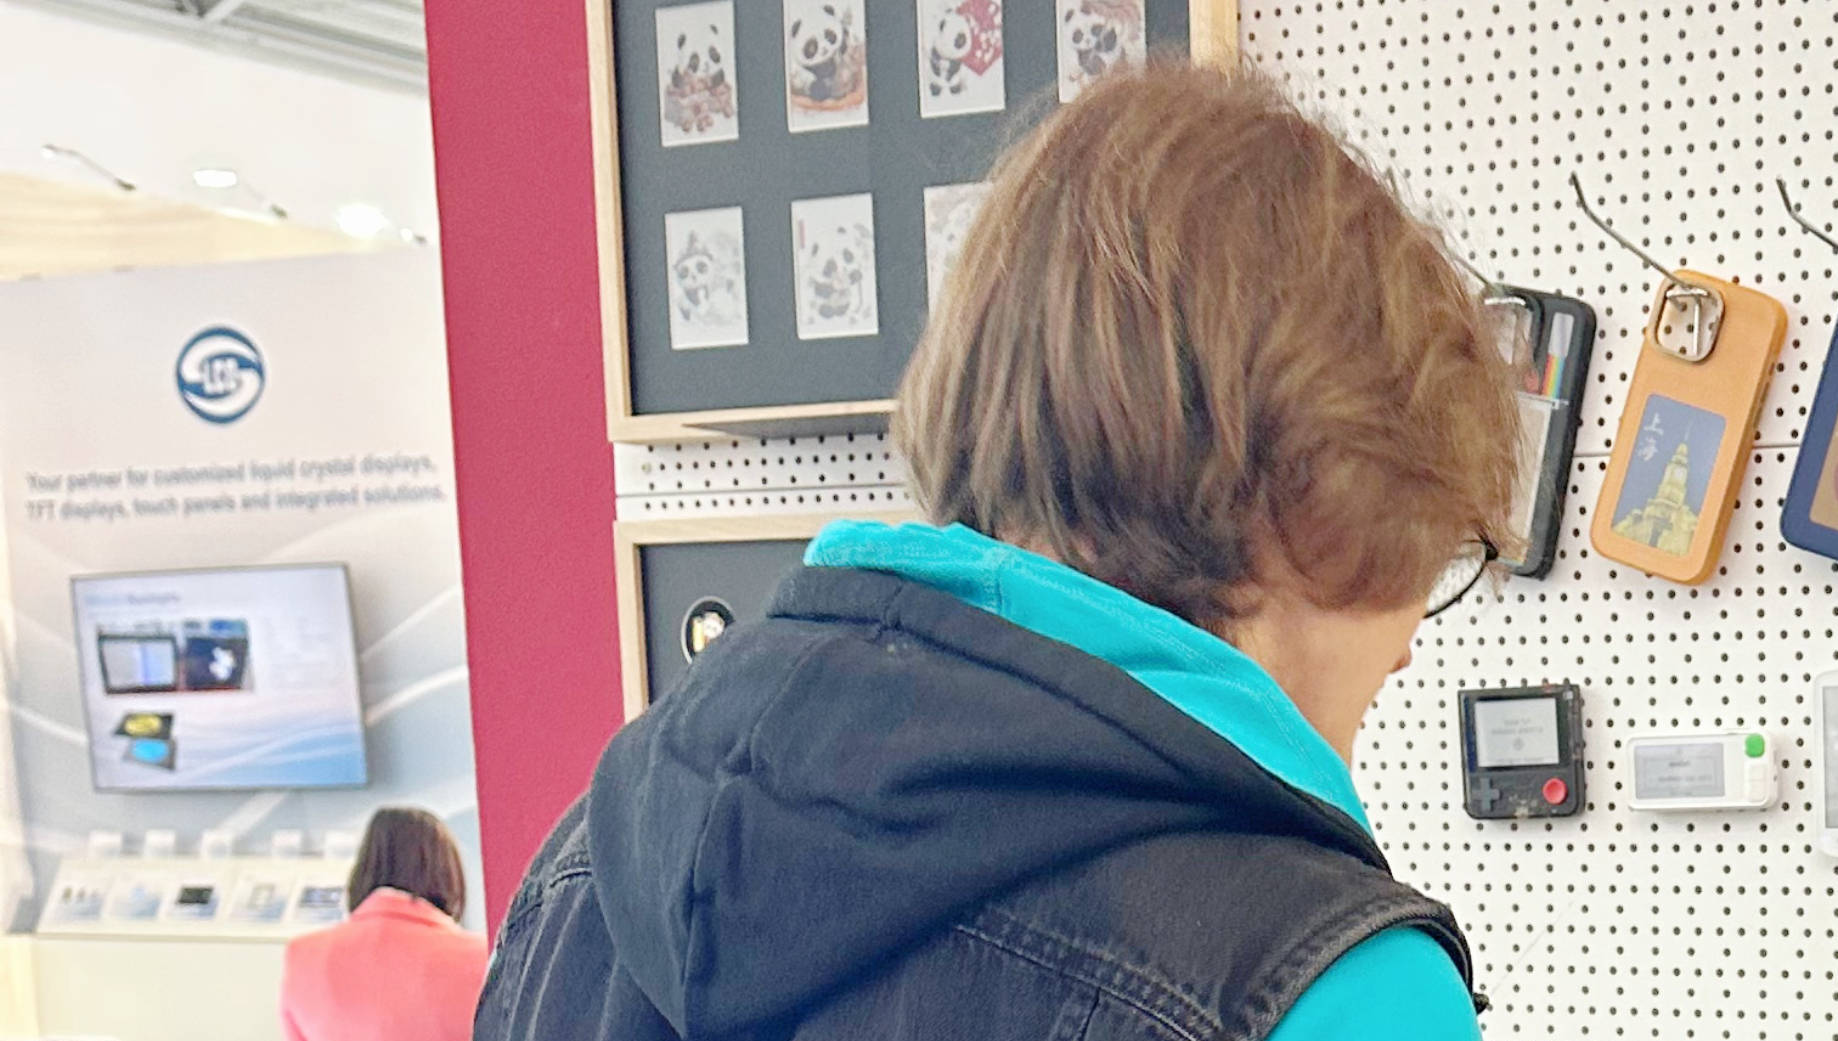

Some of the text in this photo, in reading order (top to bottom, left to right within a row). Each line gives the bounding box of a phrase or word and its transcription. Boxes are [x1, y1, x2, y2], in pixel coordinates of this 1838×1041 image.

[26, 472, 62, 491] Your
[67, 470, 122, 494] partner
[126, 467, 148, 486] for
[154, 462, 244, 485] customized
[251, 459, 294, 481] liquid
[300, 456, 354, 483] crystal
[26, 499, 55, 520] TFT
[133, 497, 178, 517] touch
[184, 494, 236, 518] panels
[242, 490, 270, 510] and
[276, 485, 359, 513] integrated
